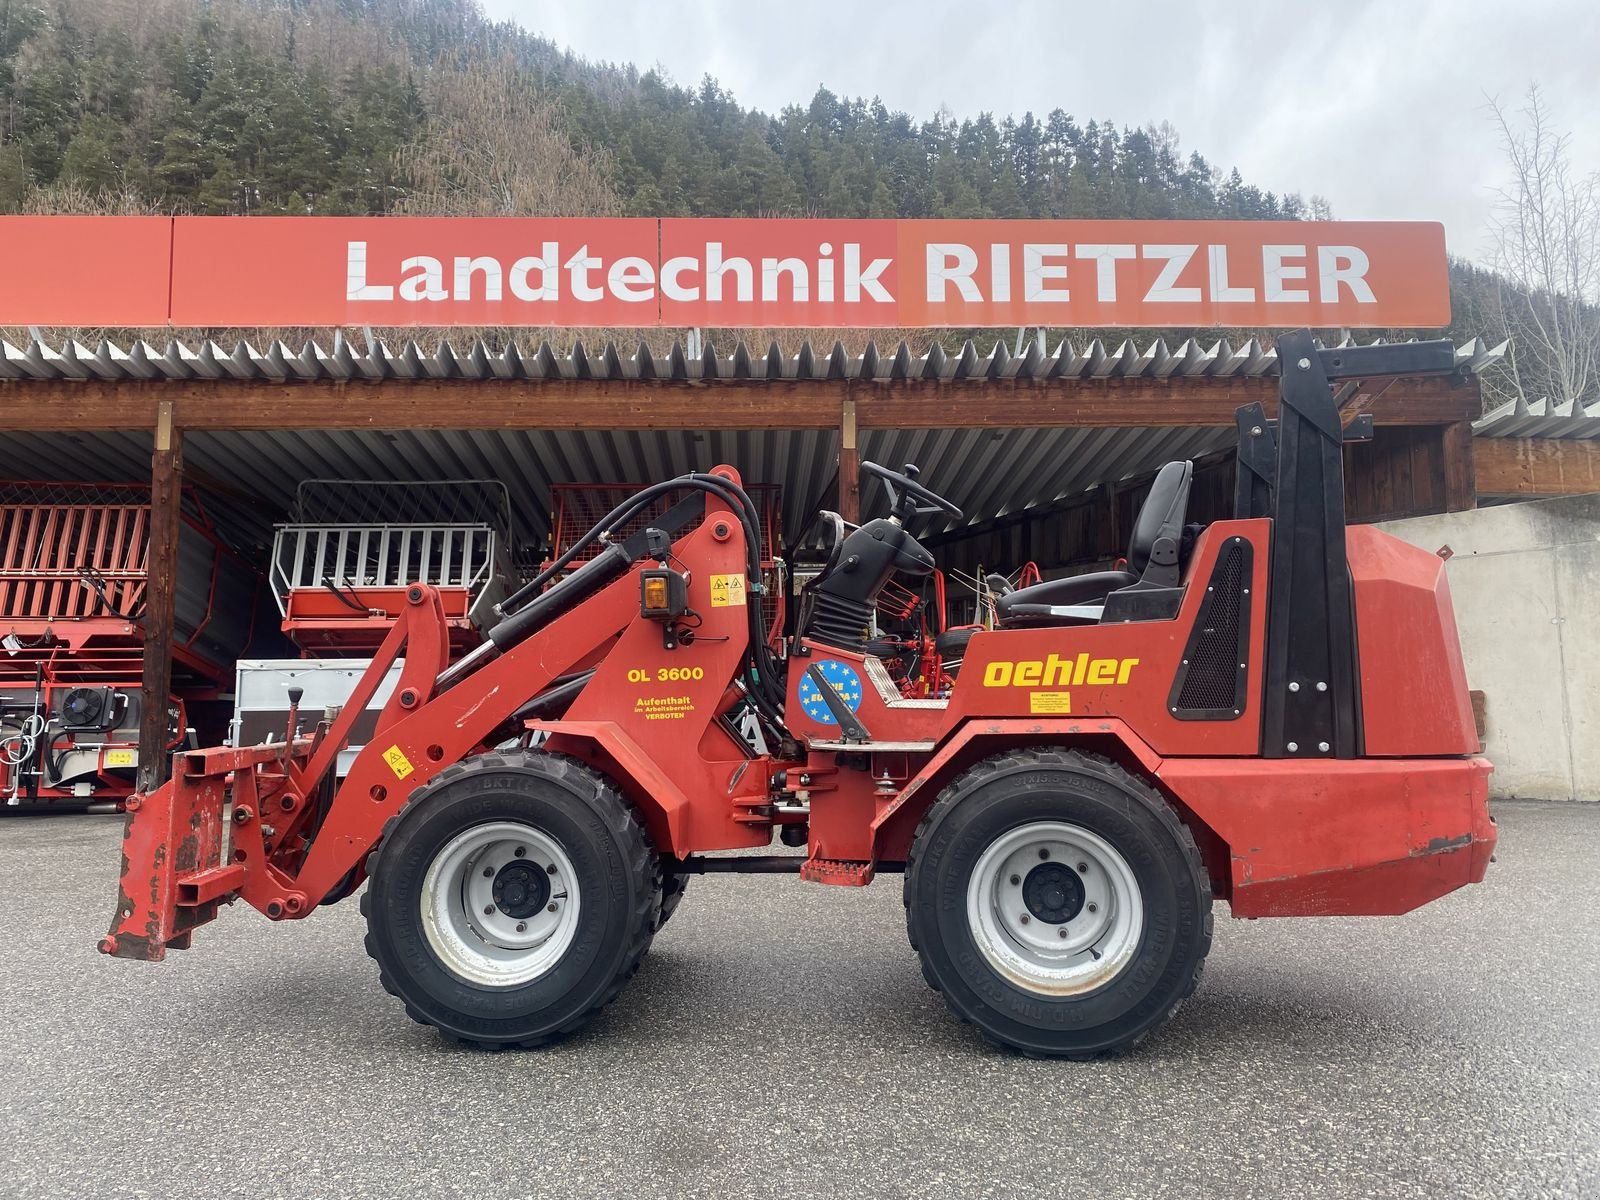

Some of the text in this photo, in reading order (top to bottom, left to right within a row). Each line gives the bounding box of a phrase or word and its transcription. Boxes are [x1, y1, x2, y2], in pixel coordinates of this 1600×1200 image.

[347, 241, 1378, 303] Landtechnik RIETZLER
[627, 667, 704, 683] OL 3600
[983, 653, 1140, 687] oehler
[636, 696, 691, 706] Aufenthalt
[645, 704, 695, 713] Arbeitsbereich
[645, 712, 685, 720] VERBOTEN
[482, 777, 515, 789] BKT
